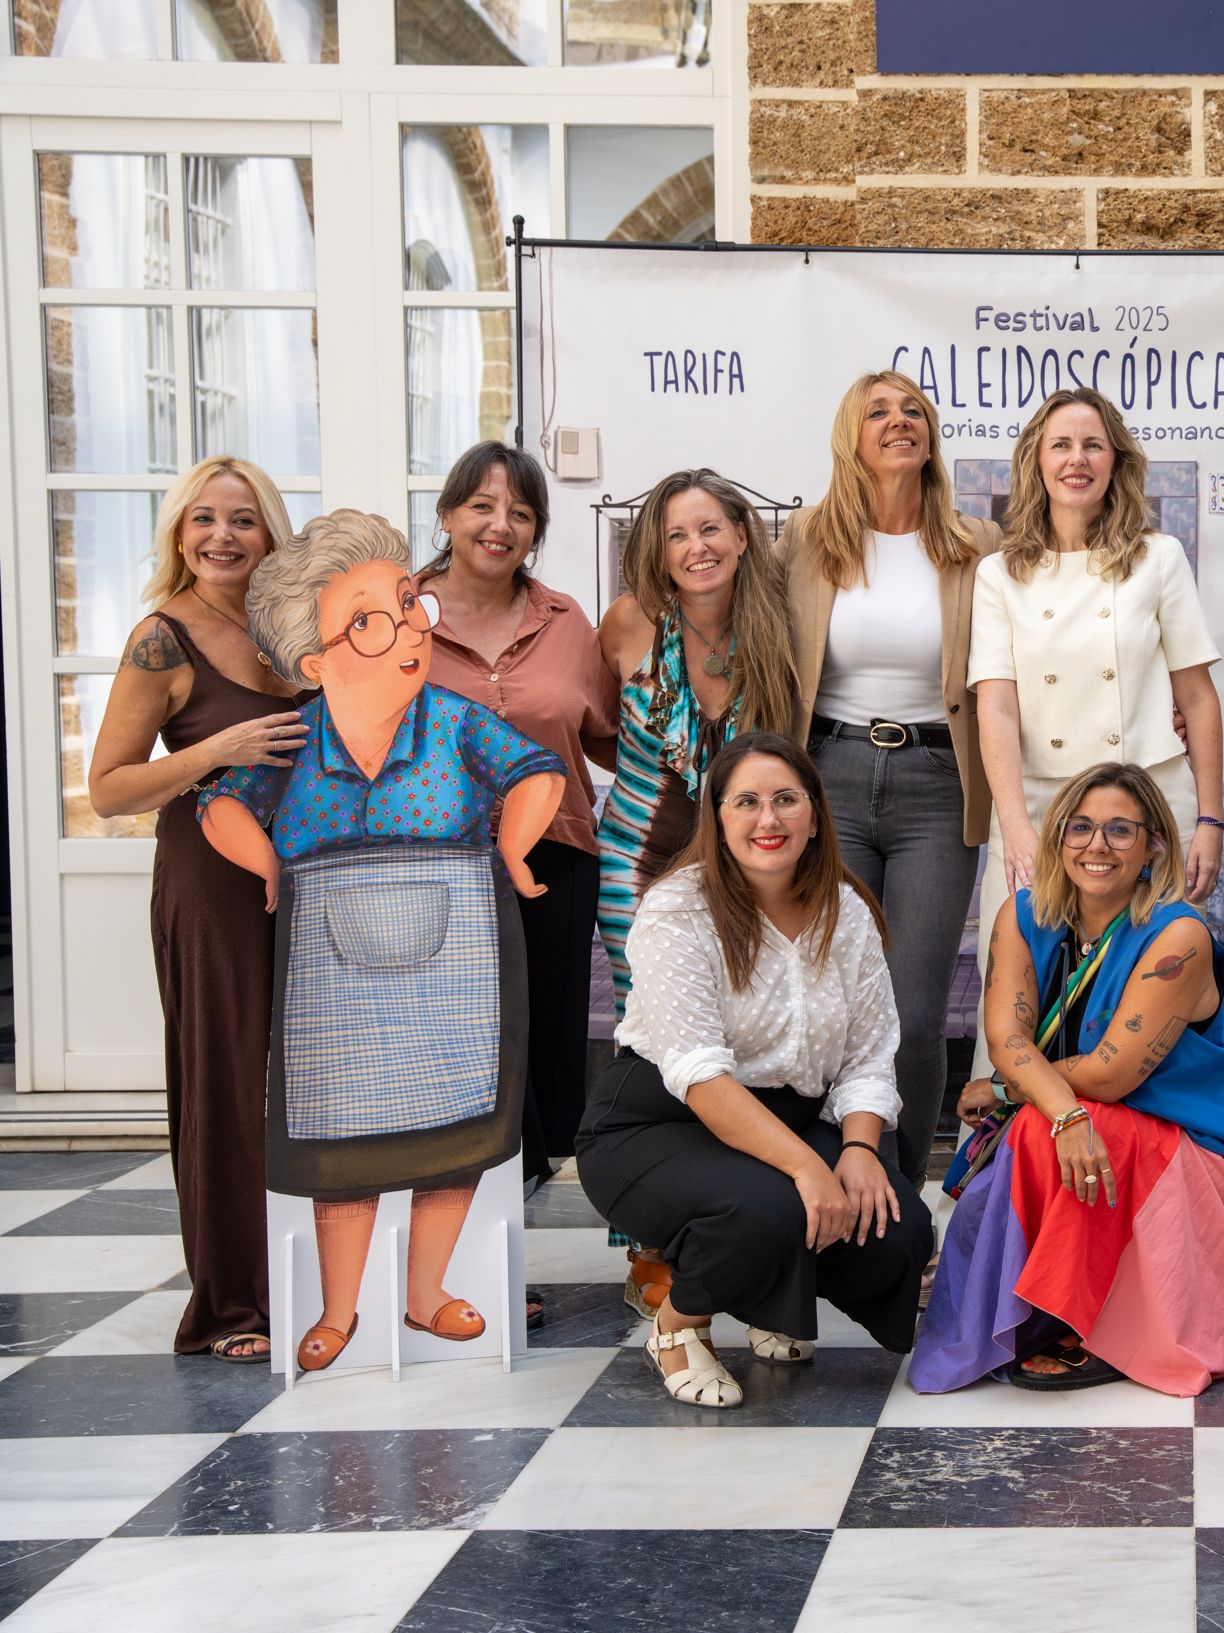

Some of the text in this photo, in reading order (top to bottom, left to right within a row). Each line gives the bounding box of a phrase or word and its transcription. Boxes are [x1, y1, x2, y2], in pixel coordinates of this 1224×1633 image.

[975, 305, 1170, 332] Festival 2025
[643, 349, 745, 395] TARIFA
